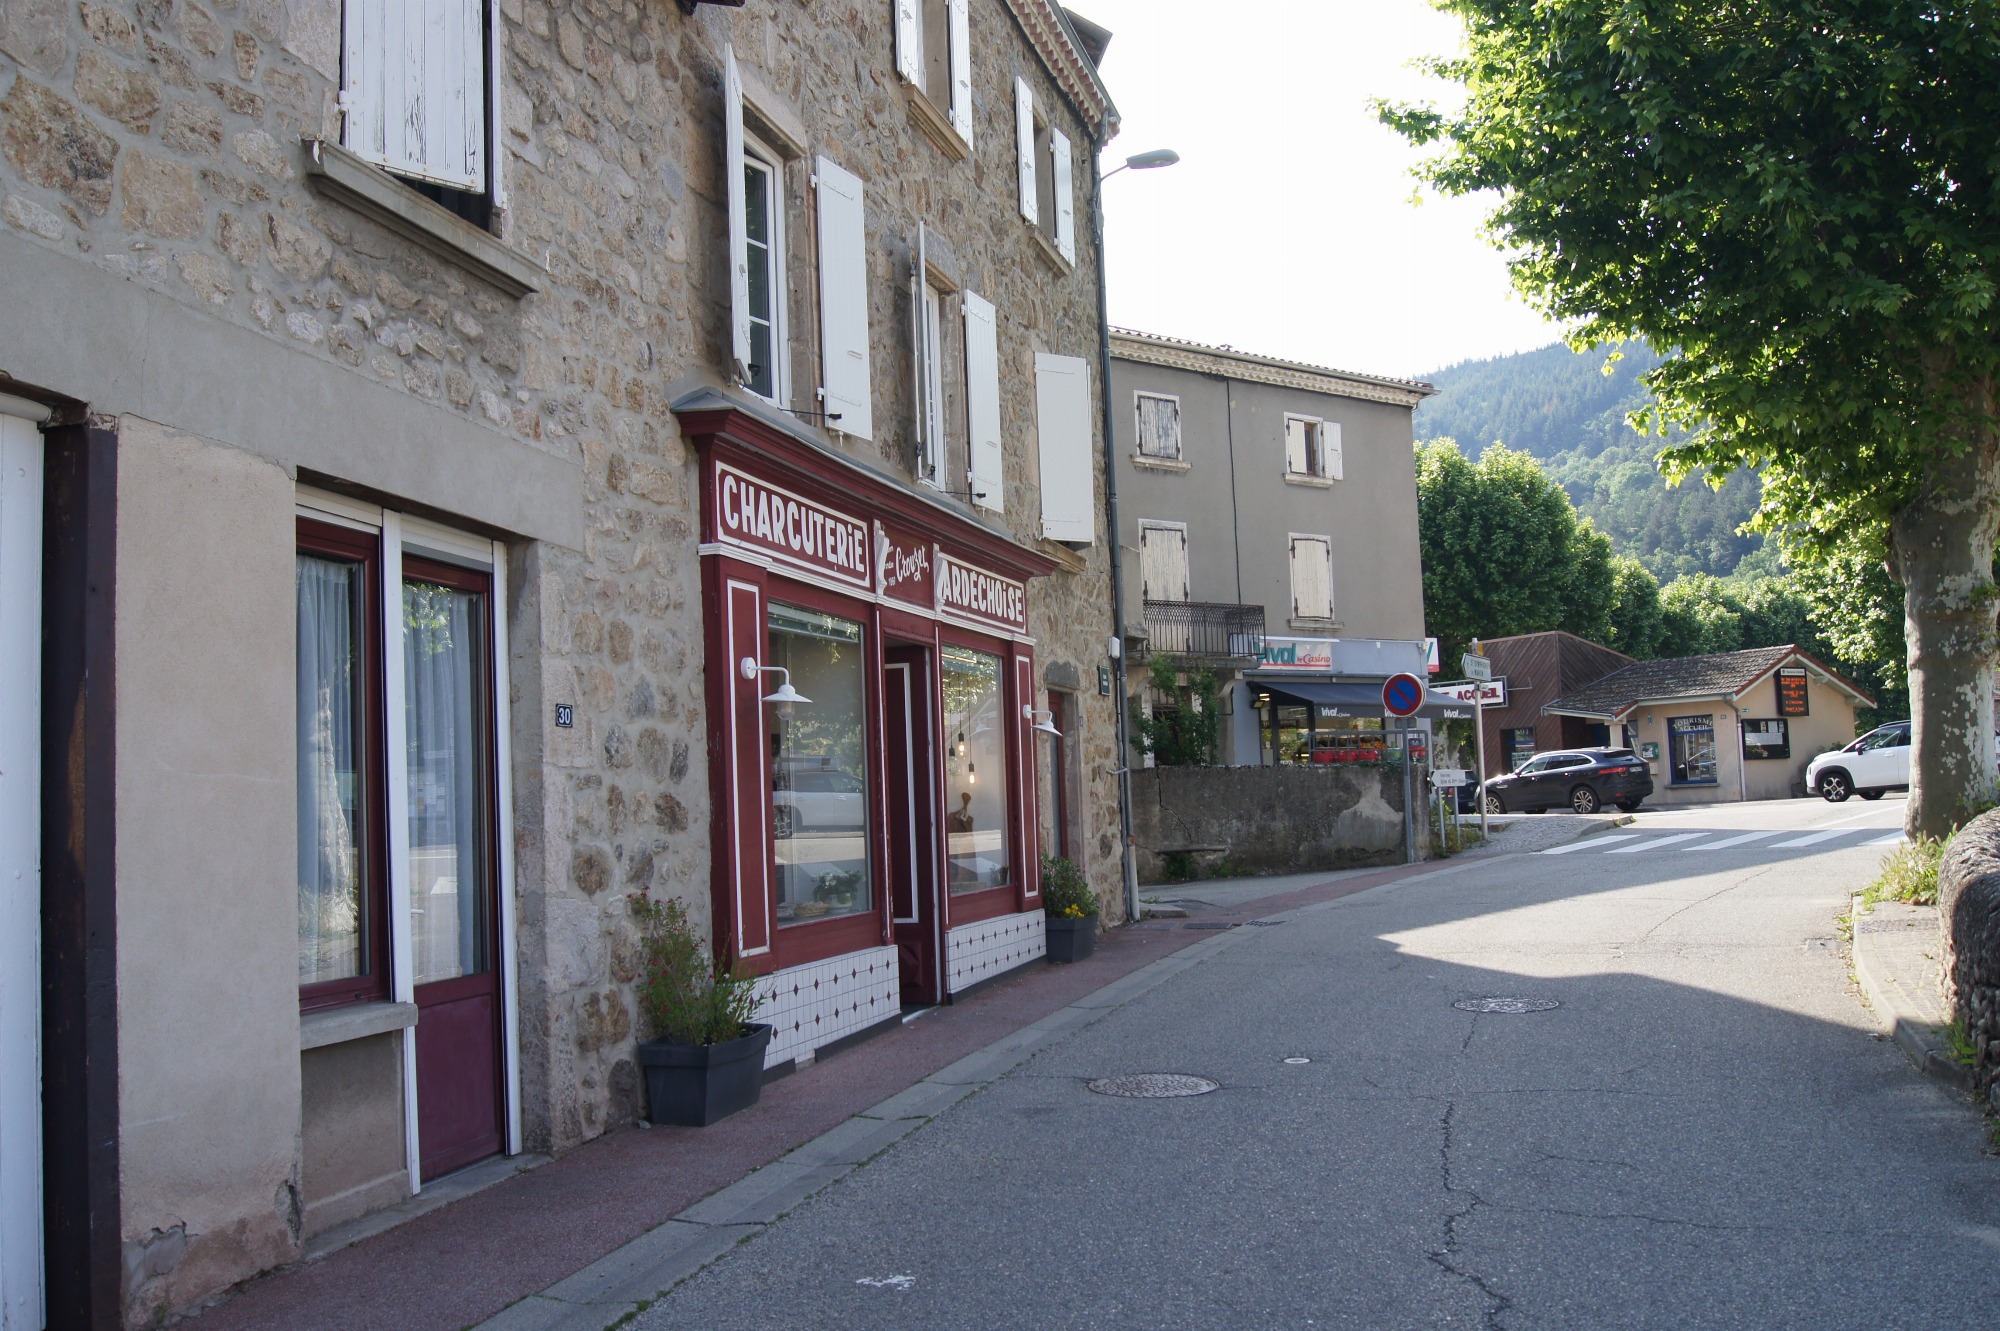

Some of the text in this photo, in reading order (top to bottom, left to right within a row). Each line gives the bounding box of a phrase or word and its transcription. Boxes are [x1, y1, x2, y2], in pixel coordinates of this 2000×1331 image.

[895, 545, 930, 583] Crouzet
[1303, 653, 1331, 664] Casino
[558, 707, 571, 724] 30
[1321, 707, 1338, 717] Vival
[1443, 708, 1459, 718] Vival
[1672, 717, 1714, 729] TOURISME
[1678, 724, 1710, 732] ACCUEIL
